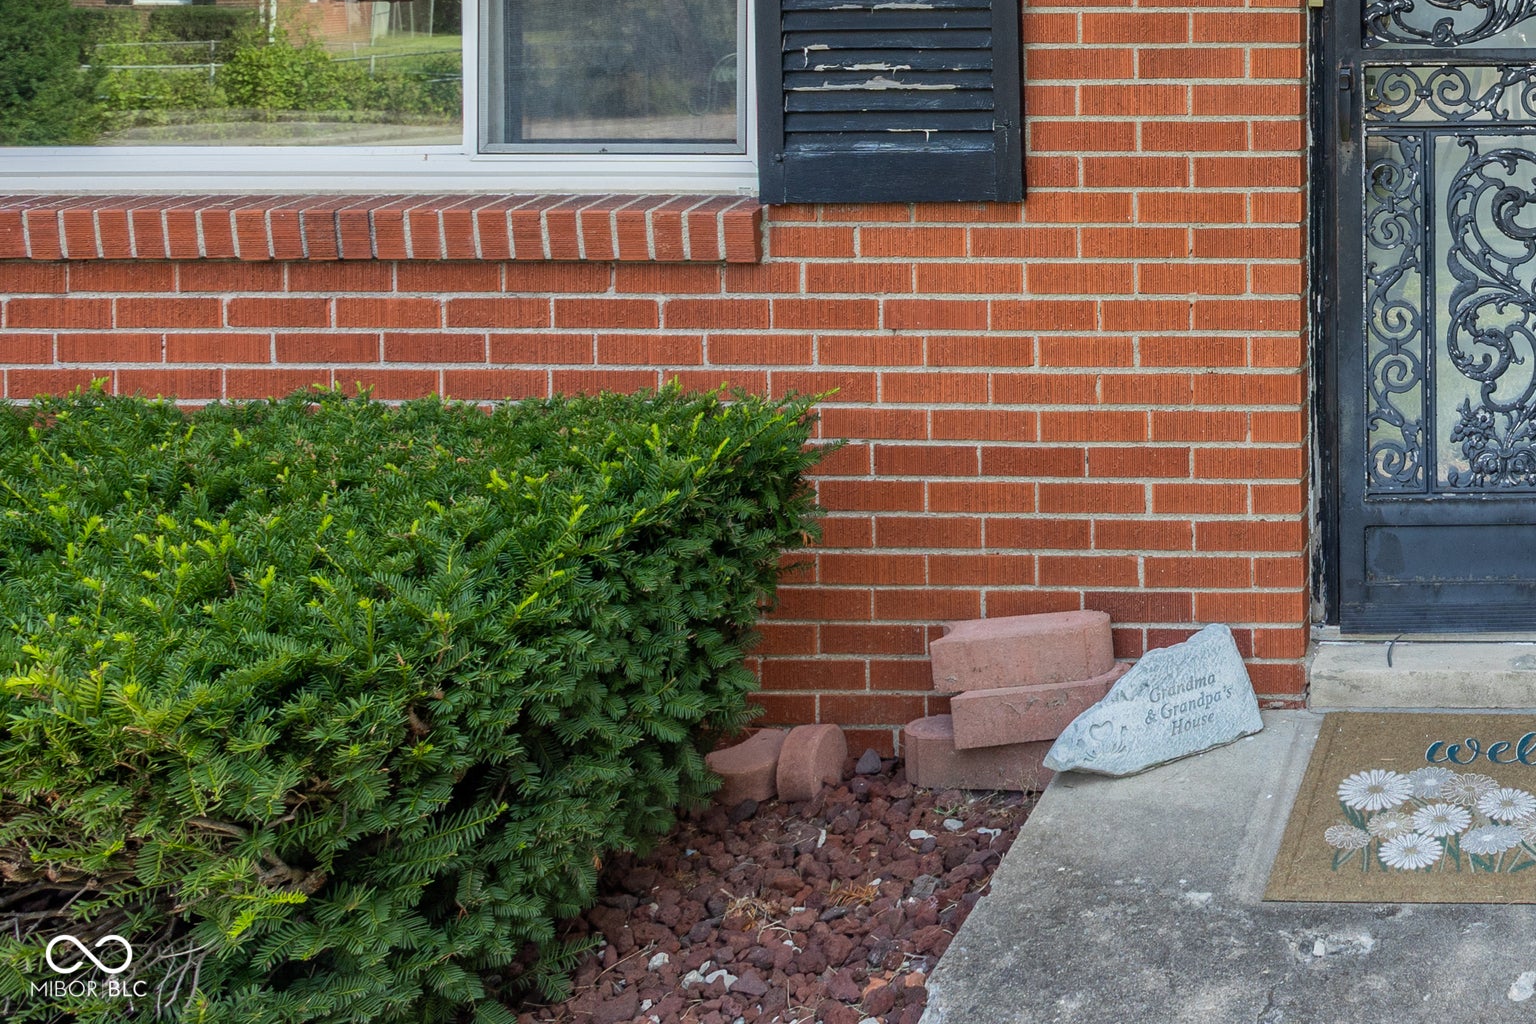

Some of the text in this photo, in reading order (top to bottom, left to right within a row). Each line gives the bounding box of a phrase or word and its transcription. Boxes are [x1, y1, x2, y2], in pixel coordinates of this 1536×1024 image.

[1149, 674, 1216, 703] Grandma
[1145, 686, 1232, 725] & Grandpa's
[1171, 713, 1215, 736] House
